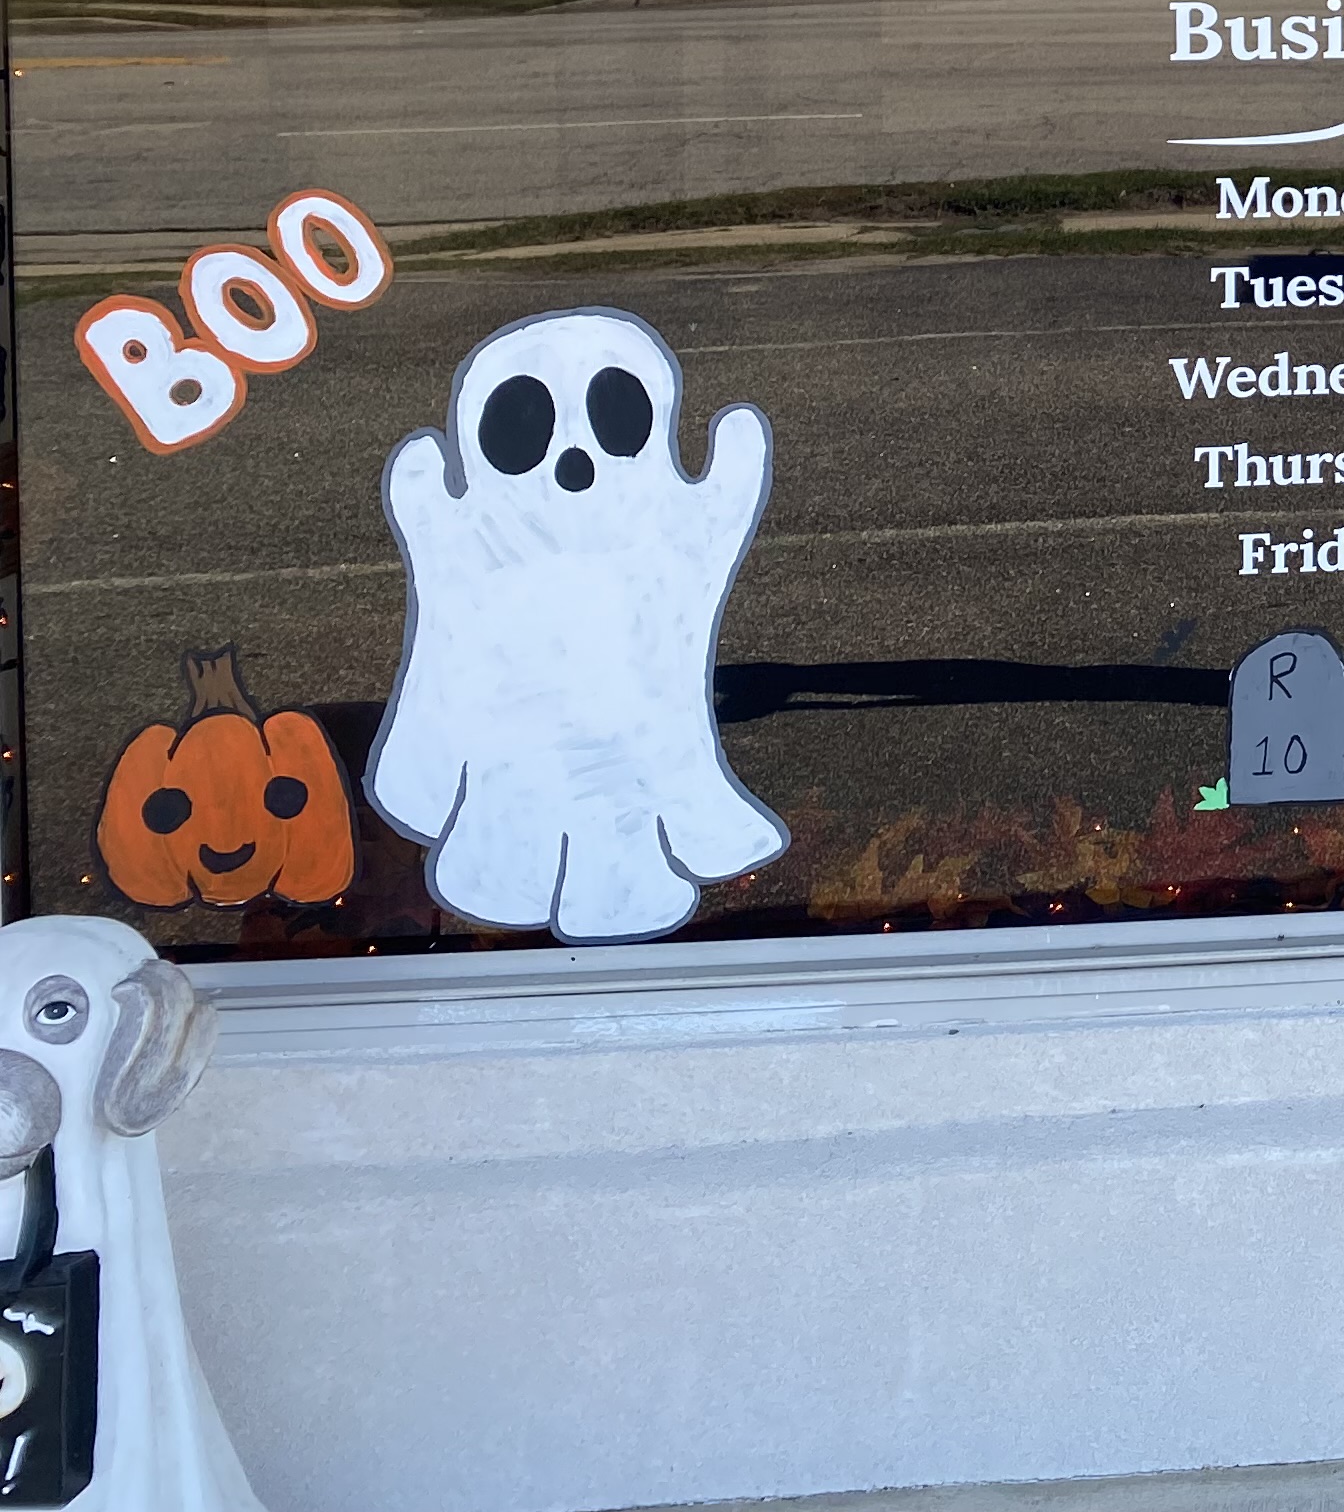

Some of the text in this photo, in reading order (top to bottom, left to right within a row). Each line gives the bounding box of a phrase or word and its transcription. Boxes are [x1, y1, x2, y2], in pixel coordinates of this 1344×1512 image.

[76, 189, 393, 455] BOO
[1268, 651, 1298, 701] R
[1252, 734, 1308, 776] 10
